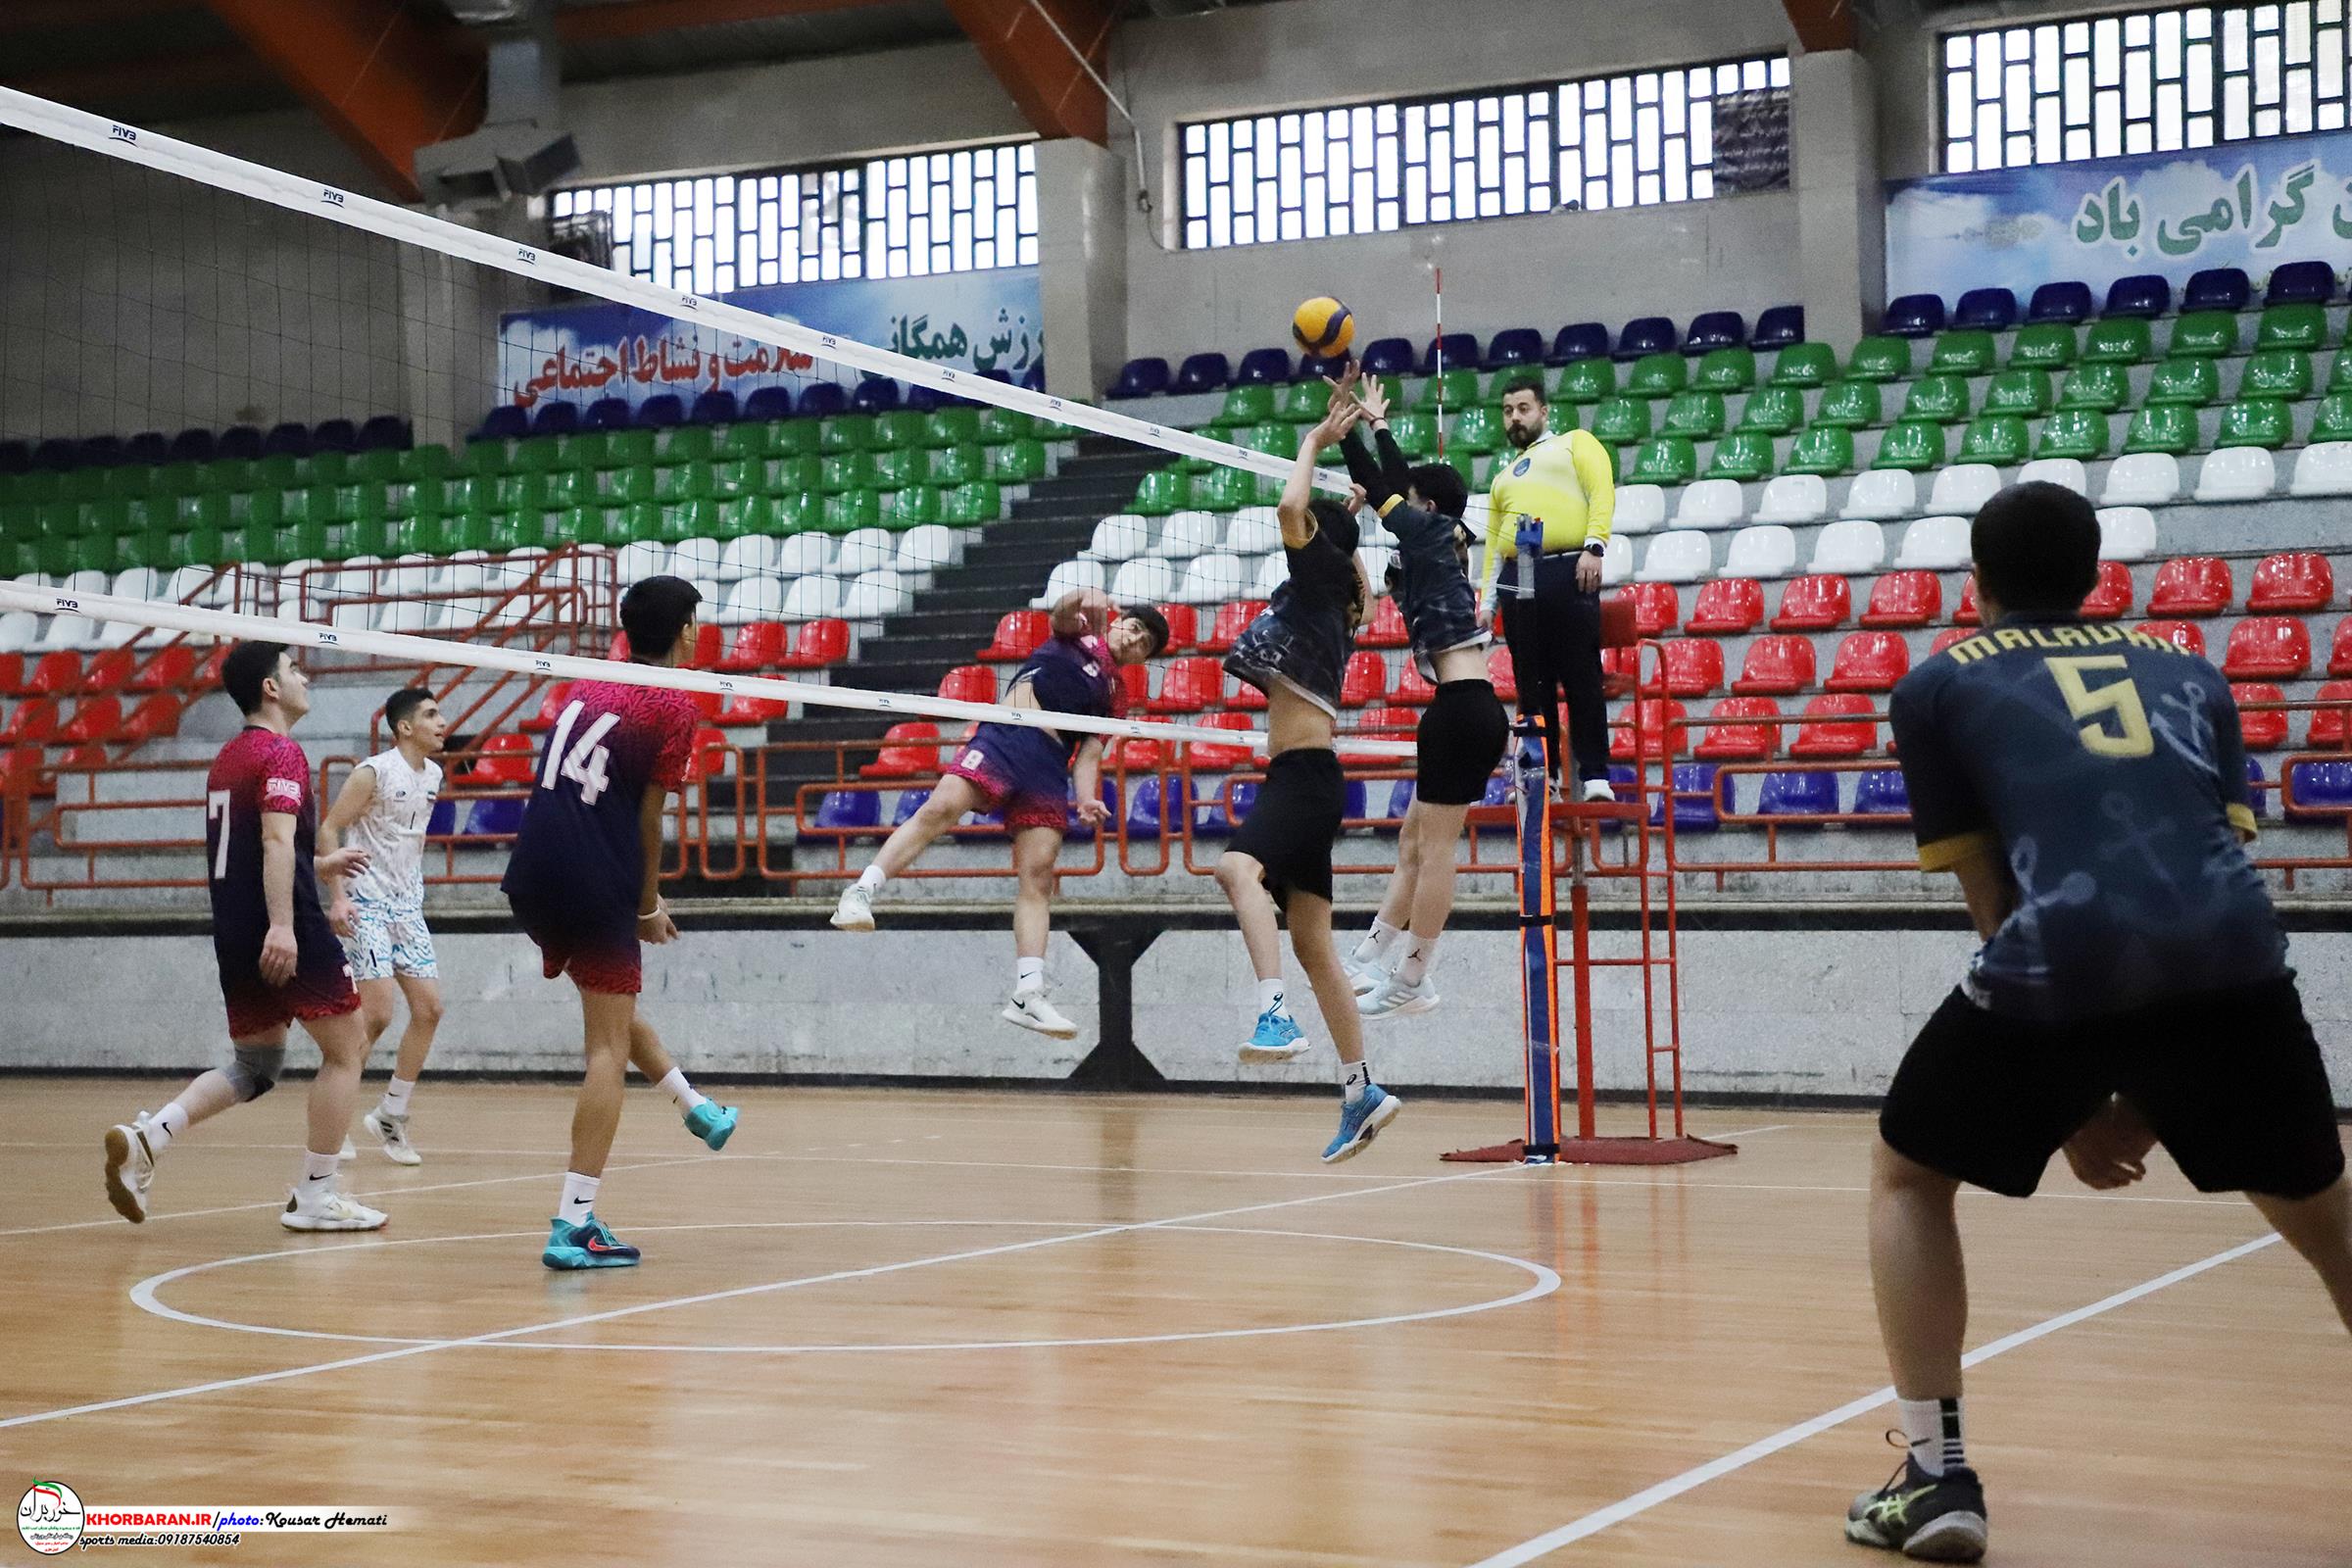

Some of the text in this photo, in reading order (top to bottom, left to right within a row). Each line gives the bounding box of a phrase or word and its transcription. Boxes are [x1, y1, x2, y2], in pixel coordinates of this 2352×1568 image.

[112, 124, 137, 141] FIVB
[322, 189, 344, 203] FIVB
[2077, 182, 2140, 257] باد
[2158, 165, 2315, 256] گرامی
[518, 248, 536, 262] FIVB
[56, 598, 78, 609] FIVB
[2043, 655, 2154, 757] 5
[541, 700, 620, 806] 14
[209, 790, 230, 879] 7
